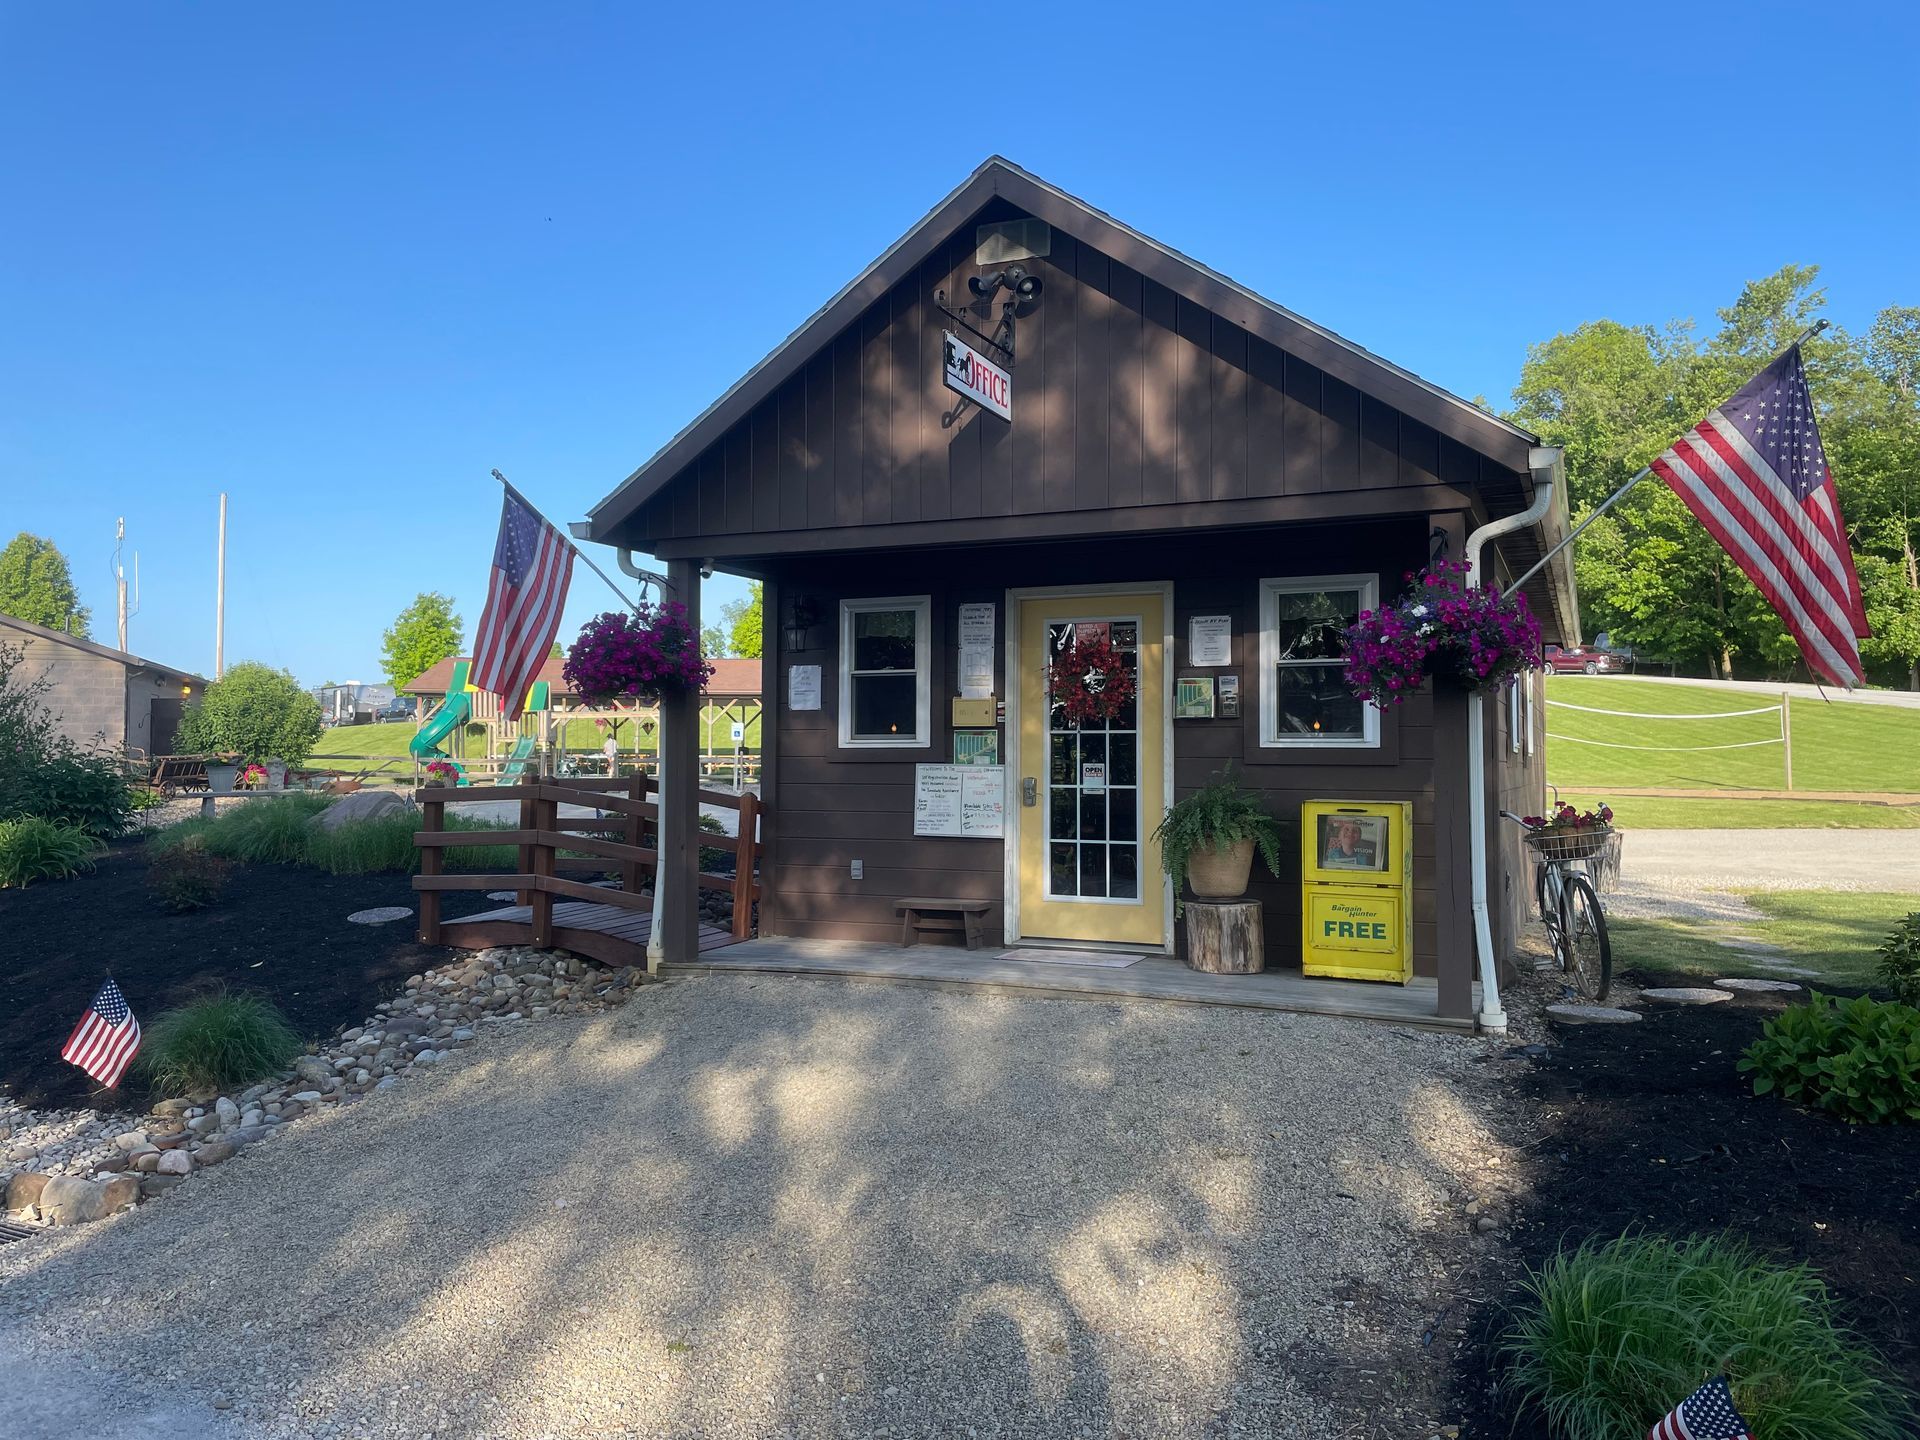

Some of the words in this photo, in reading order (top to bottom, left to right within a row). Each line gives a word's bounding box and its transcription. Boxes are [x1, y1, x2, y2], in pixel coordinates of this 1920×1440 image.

[965, 351, 1008, 409] OFFICE
[1331, 904, 1362, 913] Bargain
[1324, 920, 1387, 940] FREE
